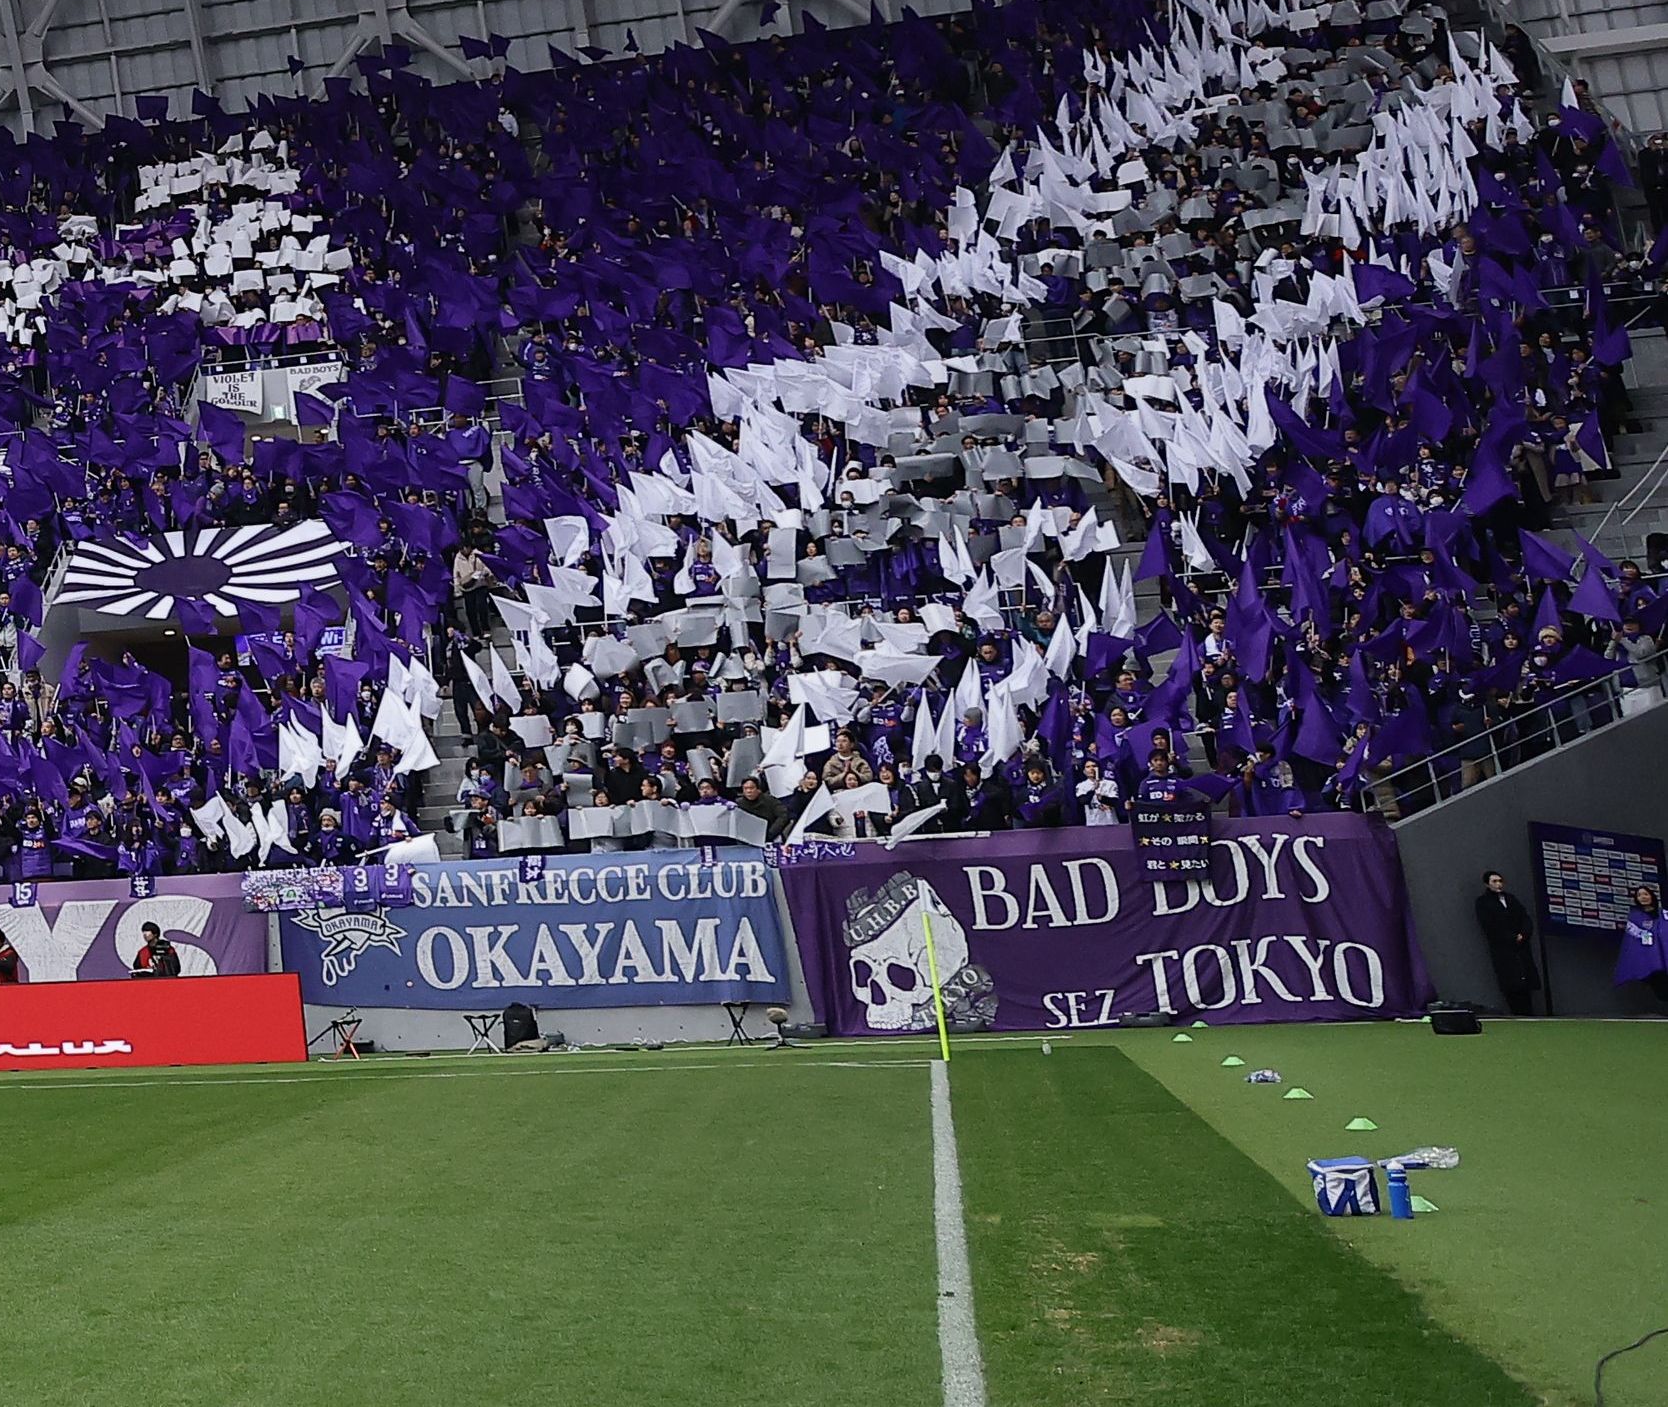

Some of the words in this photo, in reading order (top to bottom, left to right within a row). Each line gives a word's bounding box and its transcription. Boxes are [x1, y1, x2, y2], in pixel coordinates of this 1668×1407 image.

[290, 366, 311, 375] BAD
[314, 364, 339, 373] BOYS
[213, 373, 255, 384] VIOLET
[222, 392, 245, 400] THE
[228, 383, 240, 392] IS
[1152, 837, 1172, 846] その
[354, 868, 367, 886] 3
[385, 863, 399, 880] 3
[15, 882, 31, 900] 15
[413, 863, 650, 909] SANFRECCE
[658, 860, 767, 901] CLUB
[963, 857, 1120, 931] BAD
[324, 916, 378, 933] OKAYAMA
[416, 915, 776, 991] OKAYAMA
[1045, 989, 1120, 1029] SEZ
[1136, 935, 1384, 1016] TOKYO
